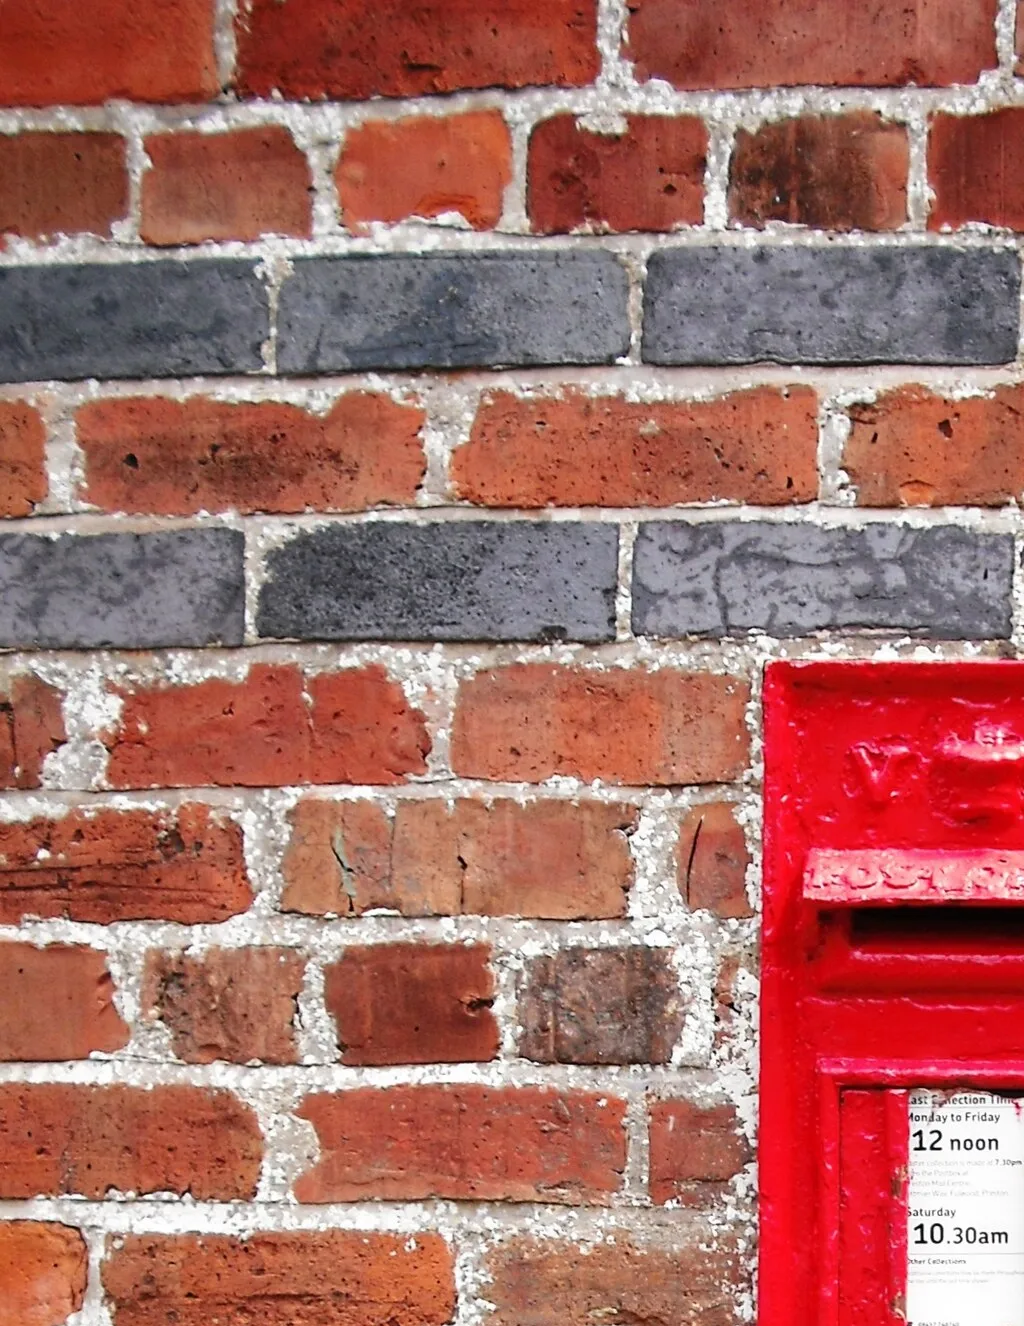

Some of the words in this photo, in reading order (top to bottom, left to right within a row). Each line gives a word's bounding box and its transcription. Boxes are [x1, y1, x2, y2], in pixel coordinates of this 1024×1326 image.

[907, 1094, 928, 1106] ast
[951, 1112, 962, 1122] to
[965, 1111, 1001, 1124] Friday
[911, 1130, 943, 1151] 12
[950, 1137, 999, 1151] noon
[995, 1159, 1023, 1168] 7.30pm
[907, 1207, 956, 1219] Saturday
[913, 1223, 1009, 1244] 10.30am
[927, 1257, 967, 1265] Collections
